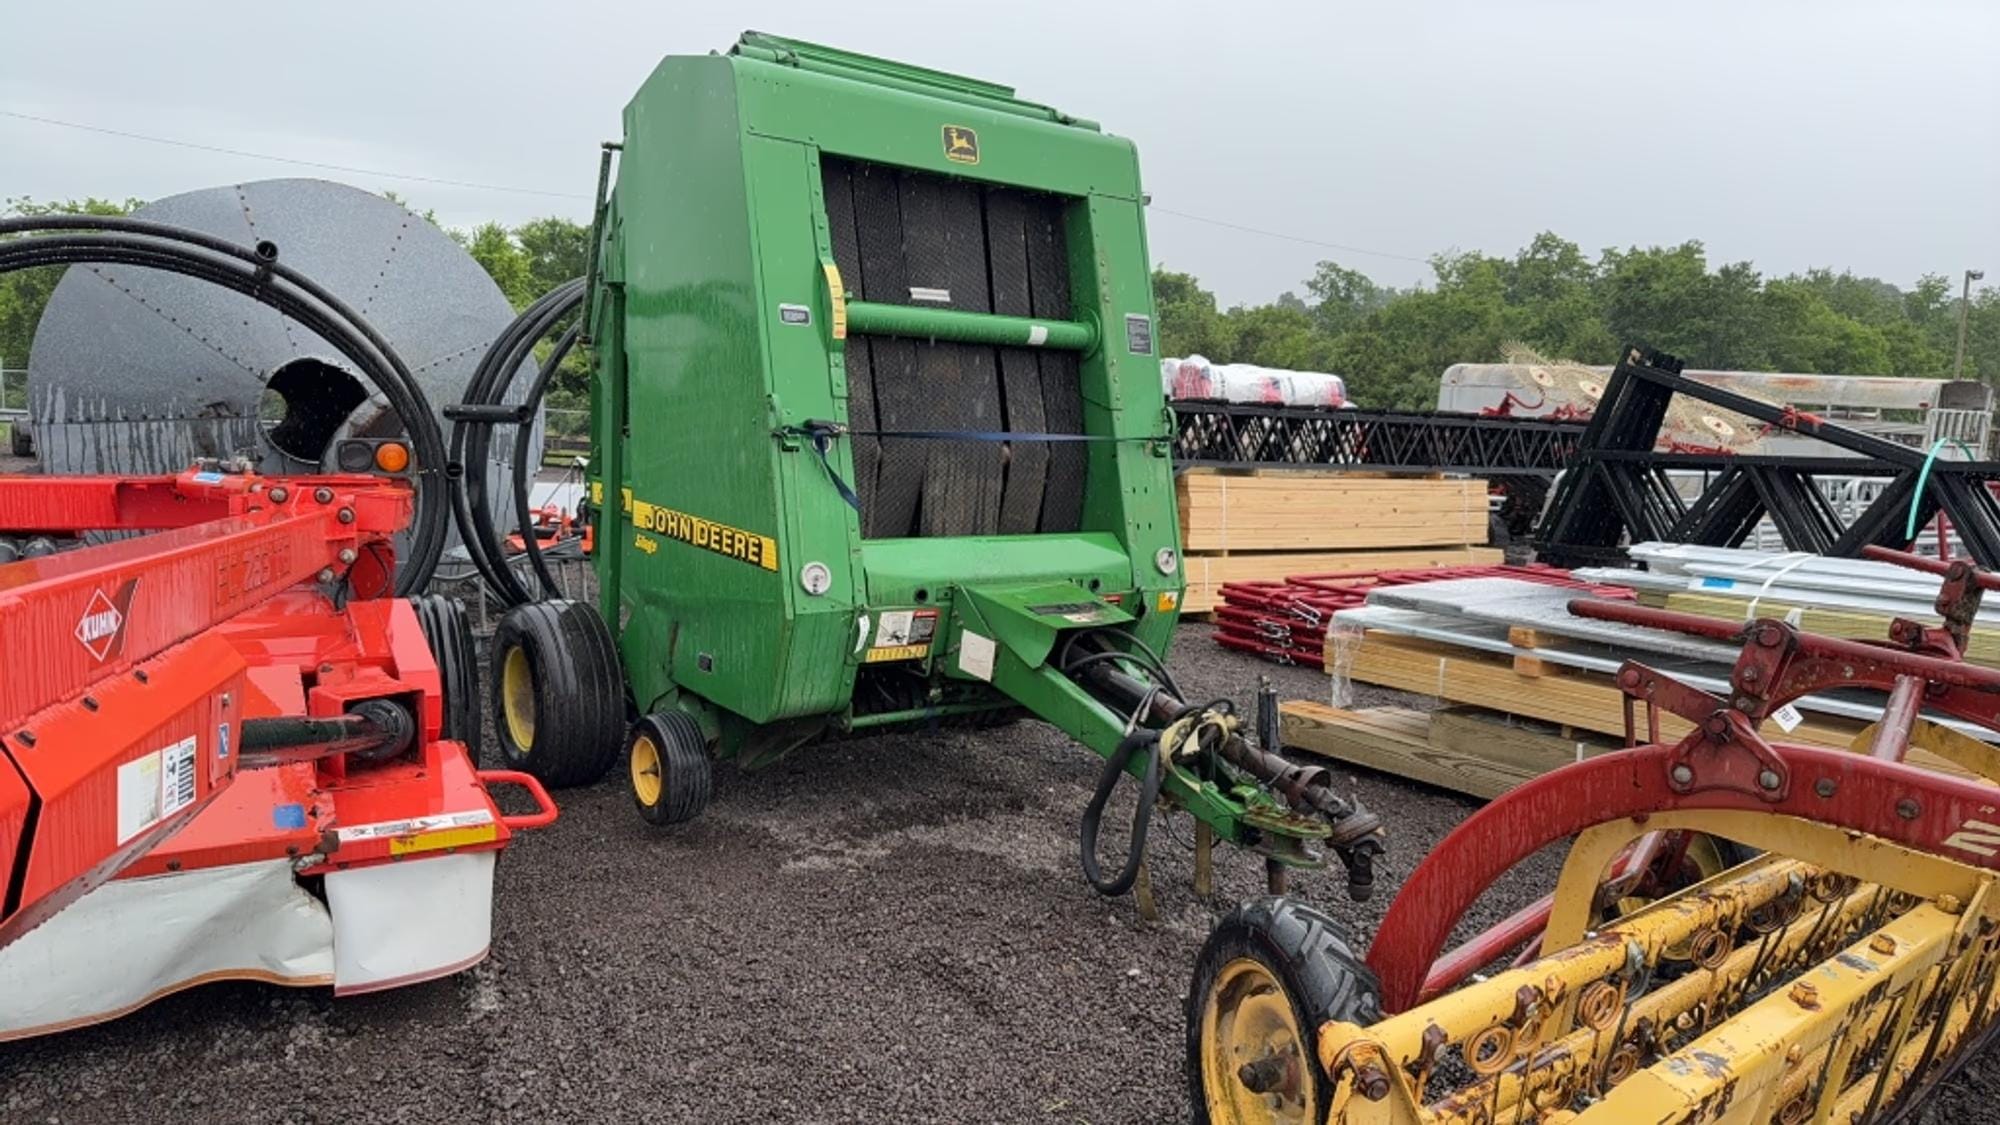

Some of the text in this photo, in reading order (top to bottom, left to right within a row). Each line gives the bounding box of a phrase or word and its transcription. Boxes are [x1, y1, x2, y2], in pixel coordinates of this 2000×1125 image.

[645, 506, 762, 563] JOHN DEERE
[82, 610, 117, 643] KUHN
